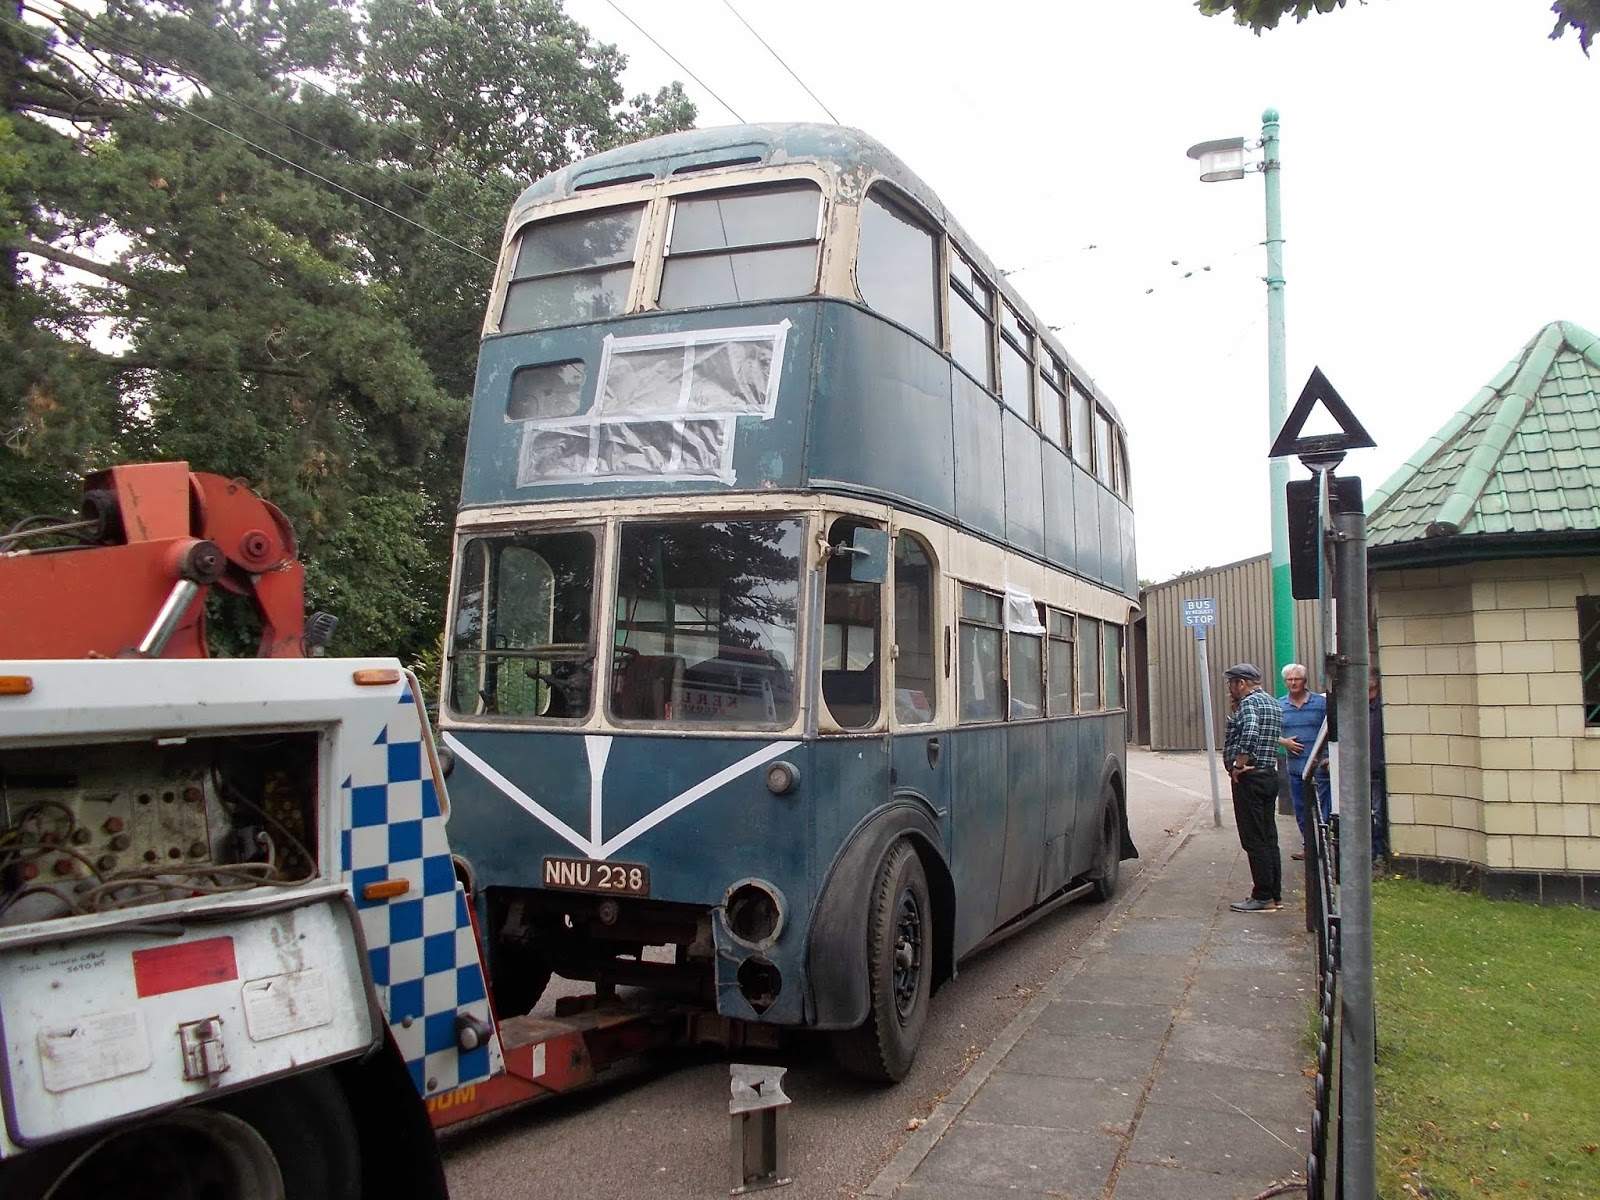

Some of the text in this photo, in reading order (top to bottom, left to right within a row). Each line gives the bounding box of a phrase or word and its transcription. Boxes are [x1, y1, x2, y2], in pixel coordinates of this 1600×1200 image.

[1188, 601, 1210, 610] BUS
[1186, 615, 1214, 625] STOP
[545, 860, 643, 890] NNU 238
